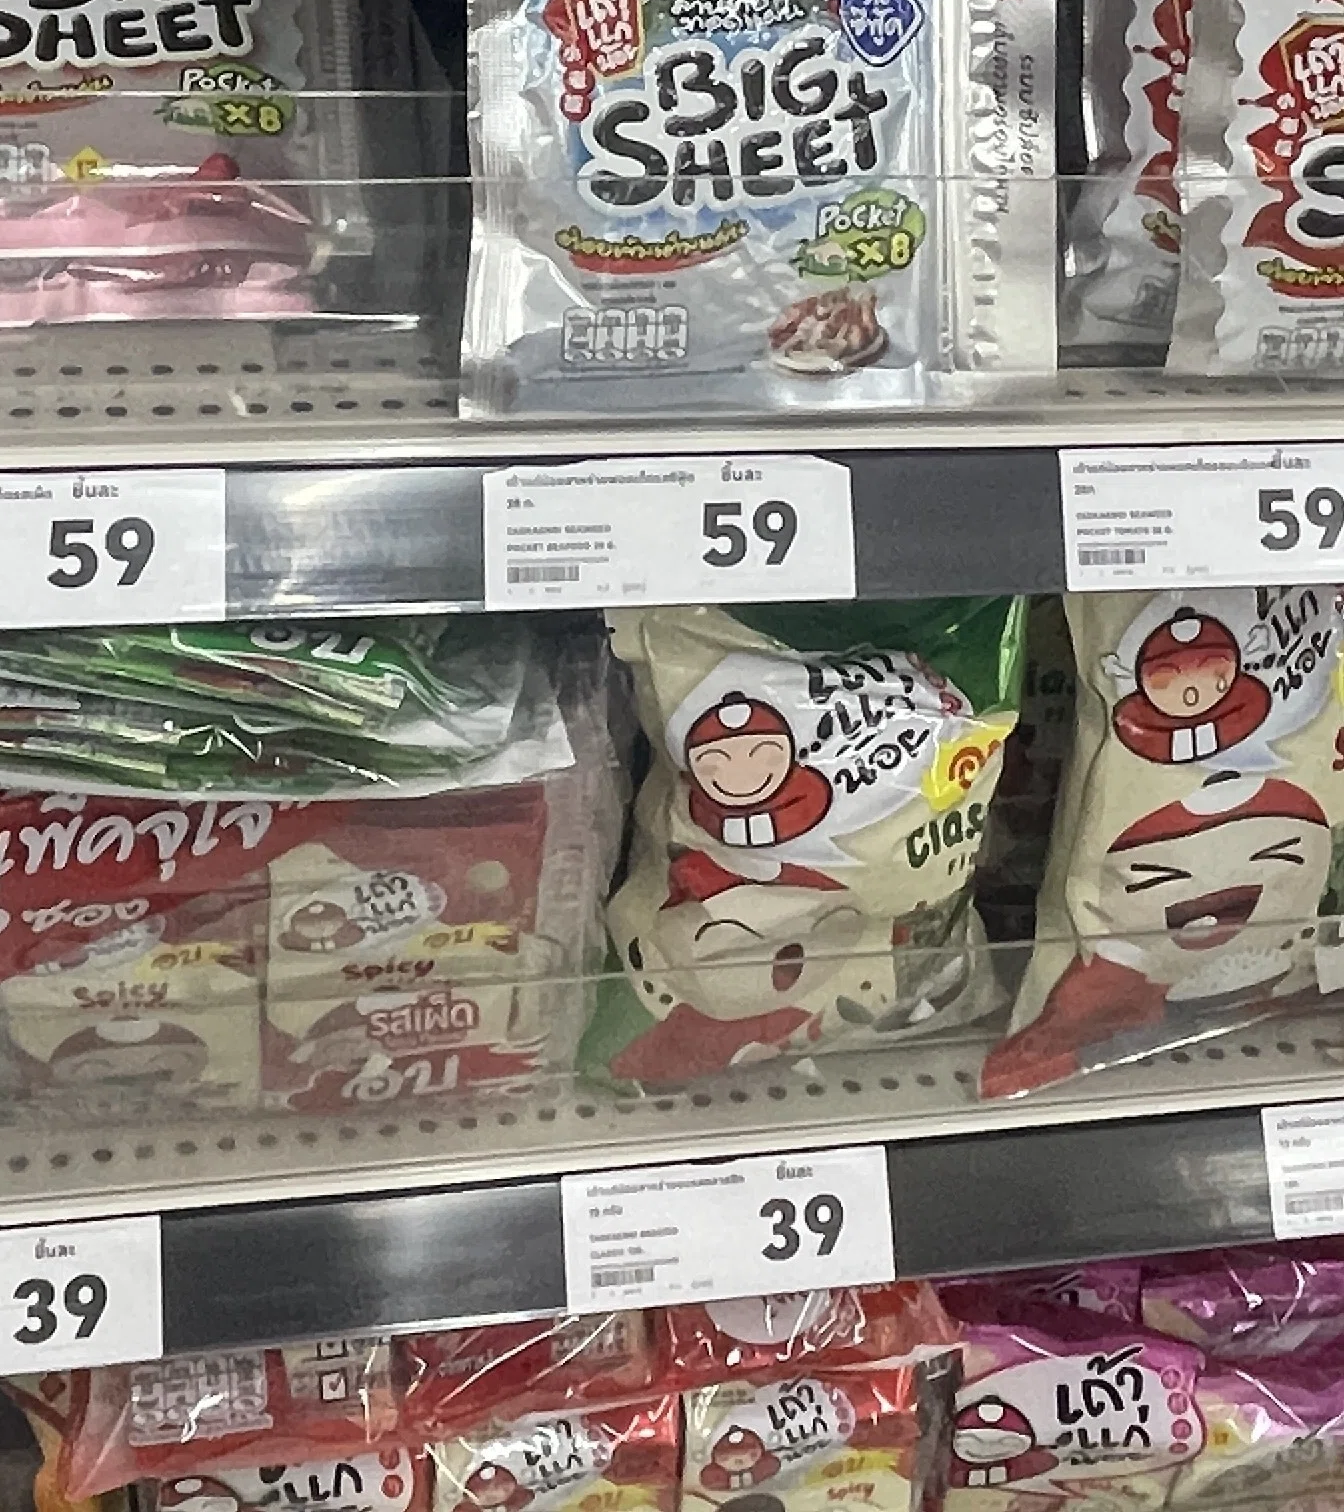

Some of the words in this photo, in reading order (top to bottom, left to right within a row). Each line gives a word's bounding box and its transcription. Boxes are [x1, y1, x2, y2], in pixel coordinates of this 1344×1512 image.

[657, 36, 840, 138] BIG
[46, 515, 156, 589] 59
[701, 499, 798, 569] 59
[759, 1193, 845, 1262] 39
[12, 1273, 109, 1345] 39
